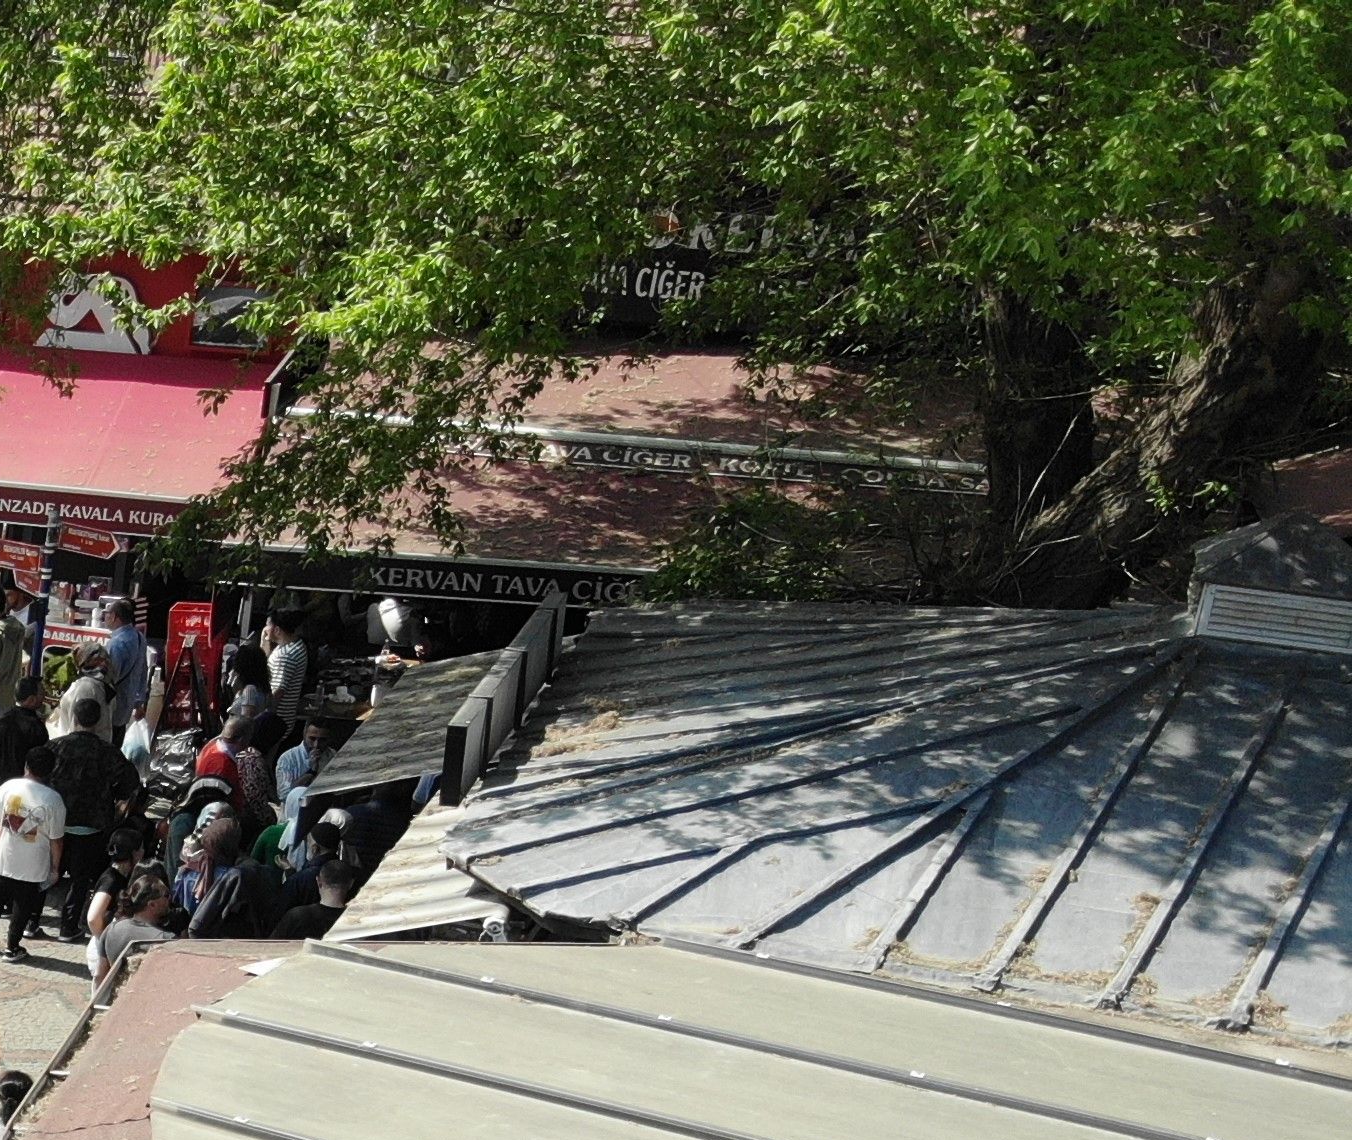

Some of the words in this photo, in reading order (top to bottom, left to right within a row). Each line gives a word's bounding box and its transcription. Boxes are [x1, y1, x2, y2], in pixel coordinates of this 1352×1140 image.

[59, 503, 124, 523] KAVALA
[370, 566, 483, 593] KERVAN
[492, 574, 562, 598] TAVA
